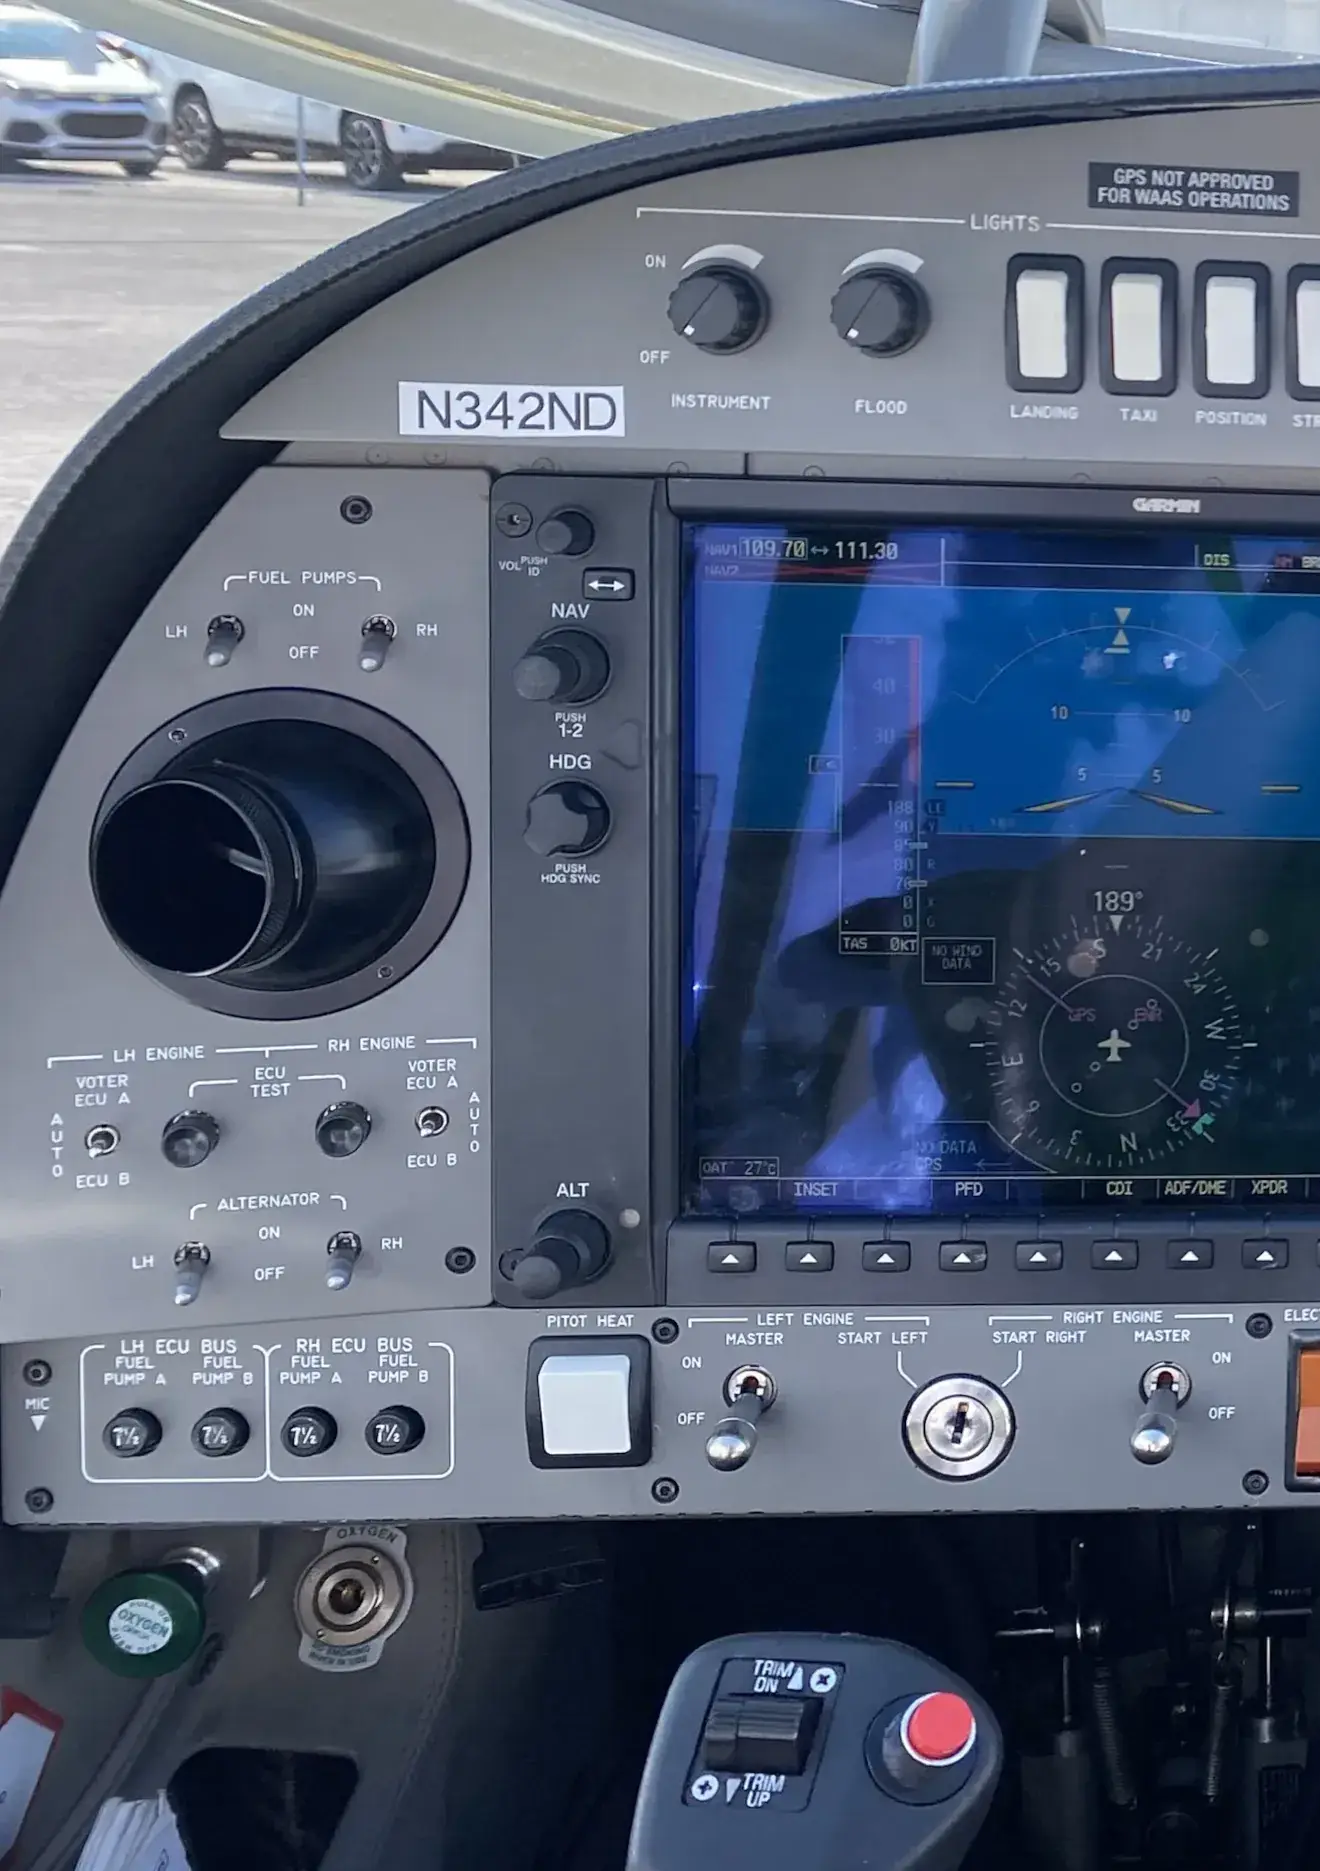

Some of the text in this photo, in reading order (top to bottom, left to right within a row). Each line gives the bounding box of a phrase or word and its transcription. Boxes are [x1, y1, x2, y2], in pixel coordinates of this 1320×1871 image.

[1114, 169, 1273, 191] GPS NOT APPROVED
[1098, 187, 1290, 211] FOR WAAS OPERATIONS
[970, 214, 1040, 231] LIGHTS
[645, 254, 666, 268] ON
[639, 349, 670, 365] OFF
[671, 393, 771, 410] INSTRUMENT
[855, 399, 908, 415] FLOOD
[417, 389, 617, 432] N342ND
[1010, 405, 1078, 421] LANDING
[1120, 408, 1158, 423] TAXI
[1195, 410, 1267, 426] POSITION
[1133, 498, 1200, 513] GARMIN
[743, 541, 805, 558] 109.70
[834, 542, 898, 559] 111.30
[248, 571, 356, 584] FUEL PUMPS
[551, 603, 590, 619] NAV
[549, 754, 592, 770] HDG
[1093, 891, 1143, 913] 189°
[328, 1036, 416, 1051] RH ENGINE
[114, 1045, 204, 1061] LH ENGINE
[76, 1074, 128, 1090] VOTER
[255, 1067, 285, 1081] ECU
[250, 1082, 290, 1097] TEST
[556, 1183, 589, 1198] ALT
[955, 1183, 983, 1197] PFD
[1106, 1180, 1133, 1195] CDI
[1165, 1180, 1226, 1195] ADF/DME
[1252, 1179, 1287, 1194] XPDR
[218, 1191, 319, 1211] ALTERNATOR
[547, 1315, 634, 1328] PITOT HEAT
[757, 1313, 854, 1326] LEFT ENGINE
[1064, 1310, 1163, 1324] RIGHT ENGINE
[726, 1332, 783, 1345] MASTER
[838, 1331, 927, 1345] START LEFT
[121, 1339, 236, 1354] LH ECU BUS
[678, 1413, 705, 1425] OFF
[338, 1525, 398, 1543] OXYGEN
[118, 1609, 169, 1637] OXYGEN
[754, 1660, 793, 1678] TRIM
[744, 1774, 785, 1791] TRIM
[746, 1793, 770, 1807] UP
